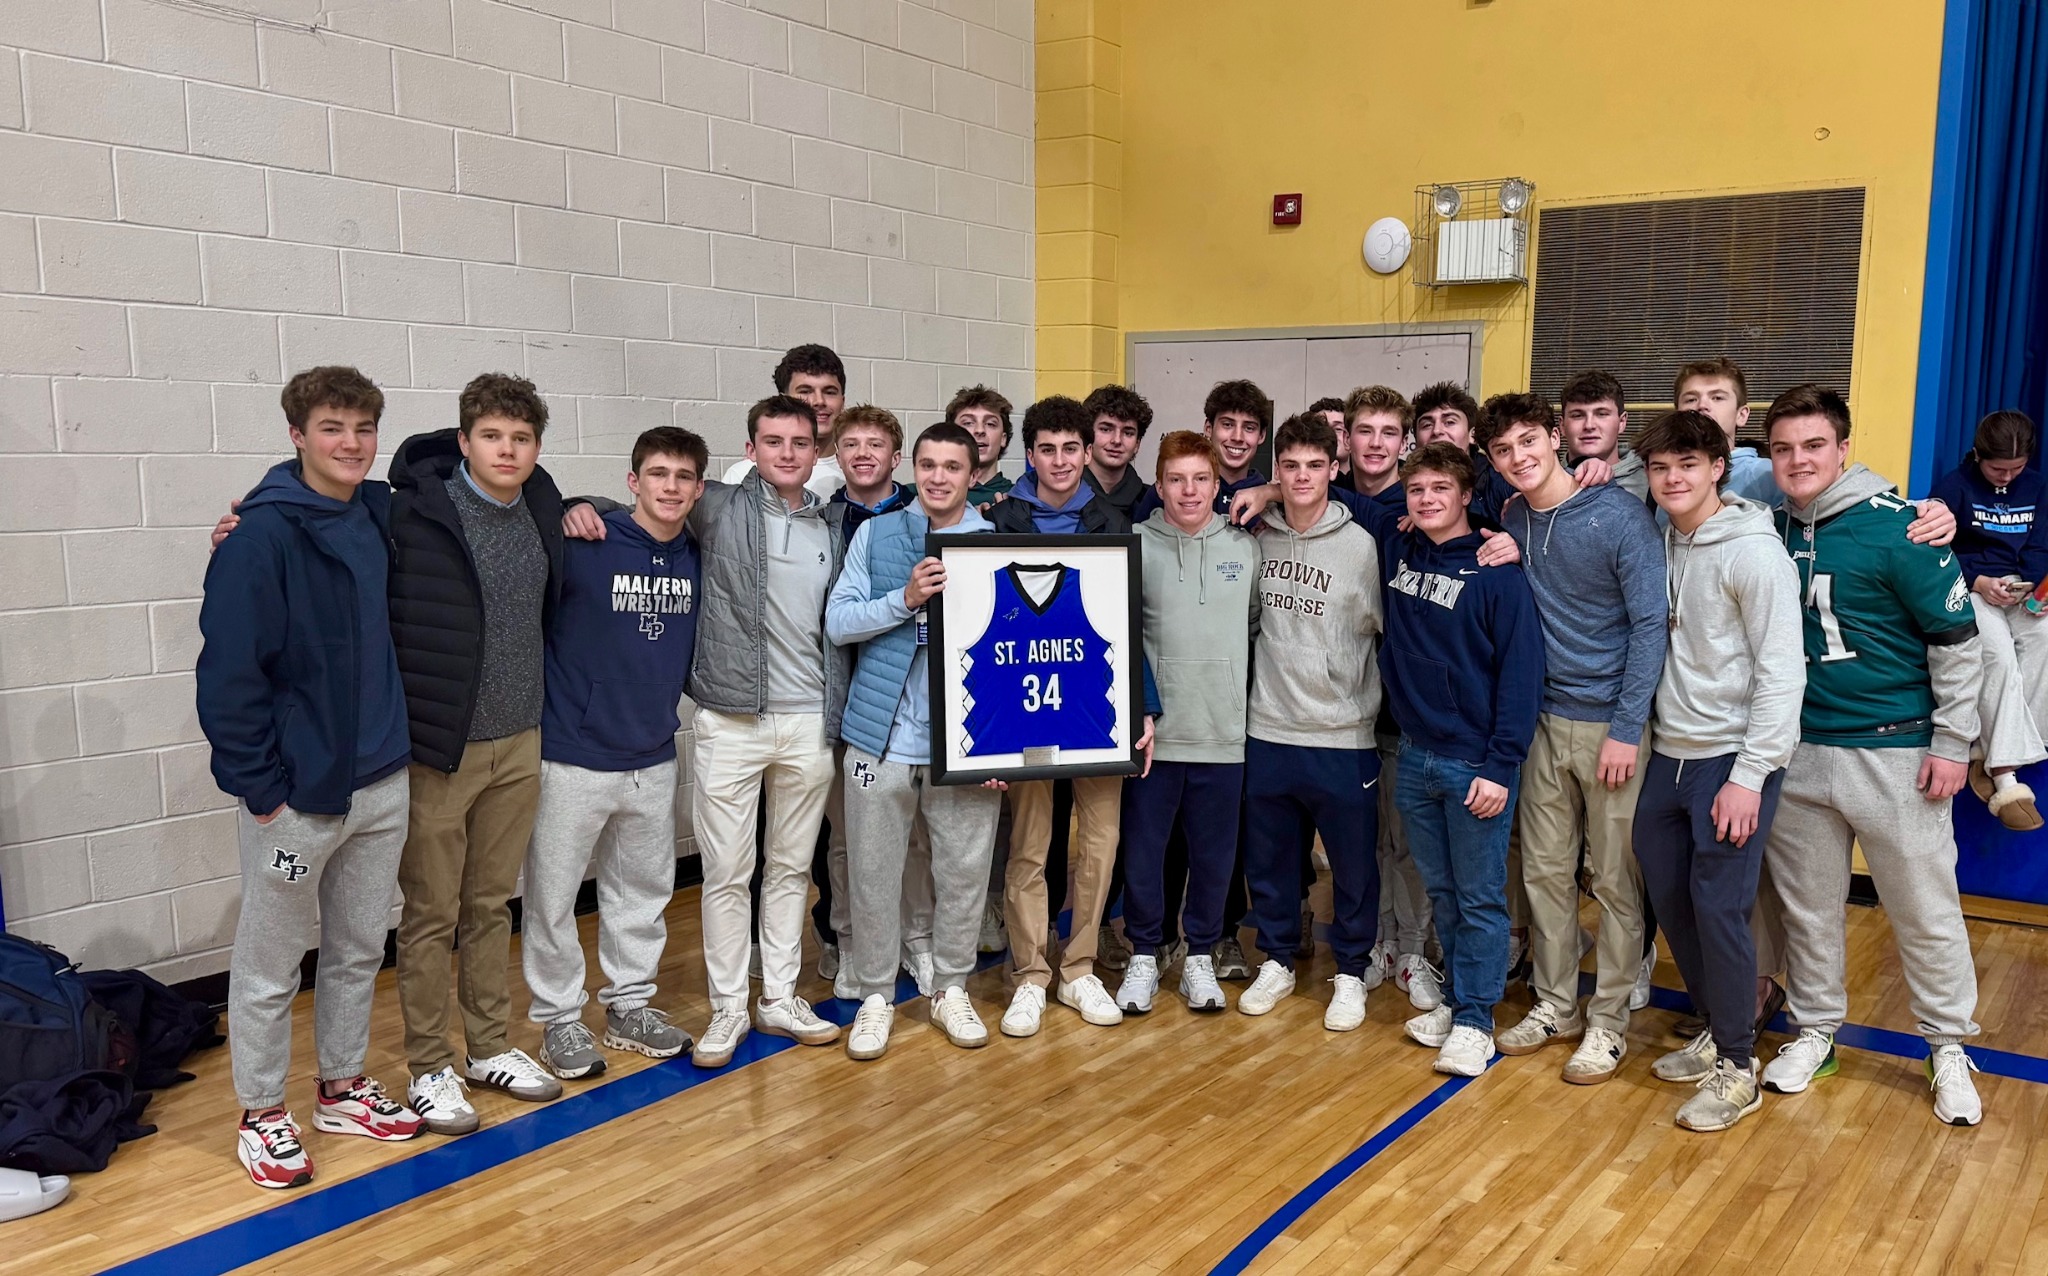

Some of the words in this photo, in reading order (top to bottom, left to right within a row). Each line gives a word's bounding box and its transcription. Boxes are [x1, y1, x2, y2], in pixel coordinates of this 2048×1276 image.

[1972, 510, 1999, 523] VILLA
[2000, 512, 2035, 524] MARI
[612, 574, 692, 597] MALVERN
[612, 593, 692, 614] WRESTLING
[639, 613, 664, 640] MP
[994, 641, 1020, 665] ST.
[1028, 638, 1084, 663] AGNES
[1022, 673, 1062, 712] 34
[270, 847, 310, 883] MP
